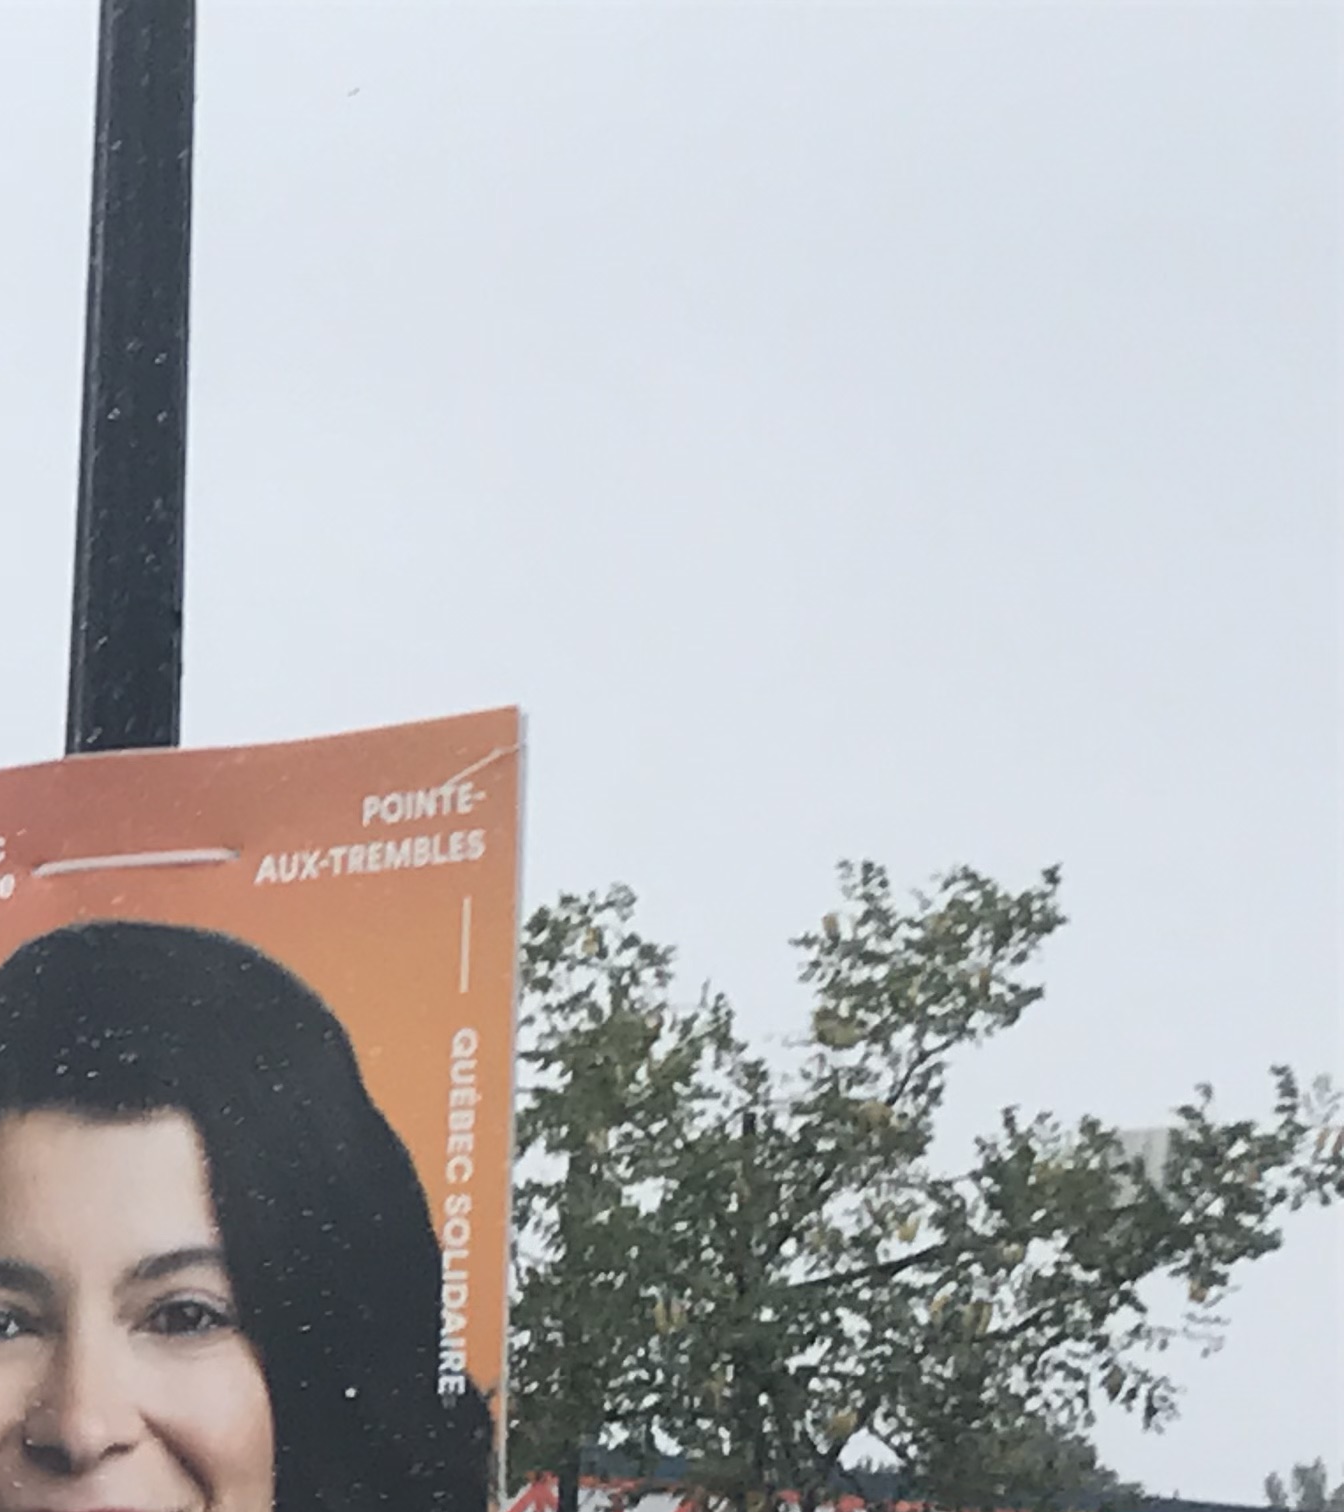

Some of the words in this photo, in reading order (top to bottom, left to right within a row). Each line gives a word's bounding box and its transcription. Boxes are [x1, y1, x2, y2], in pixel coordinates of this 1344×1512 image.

[253, 829, 487, 886] AUX-TREMBLES
[362, 781, 487, 828] POINTE-
[445, 1027, 482, 1184] QUÉBEC
[437, 1193, 472, 1395] SOLIDAIRE
